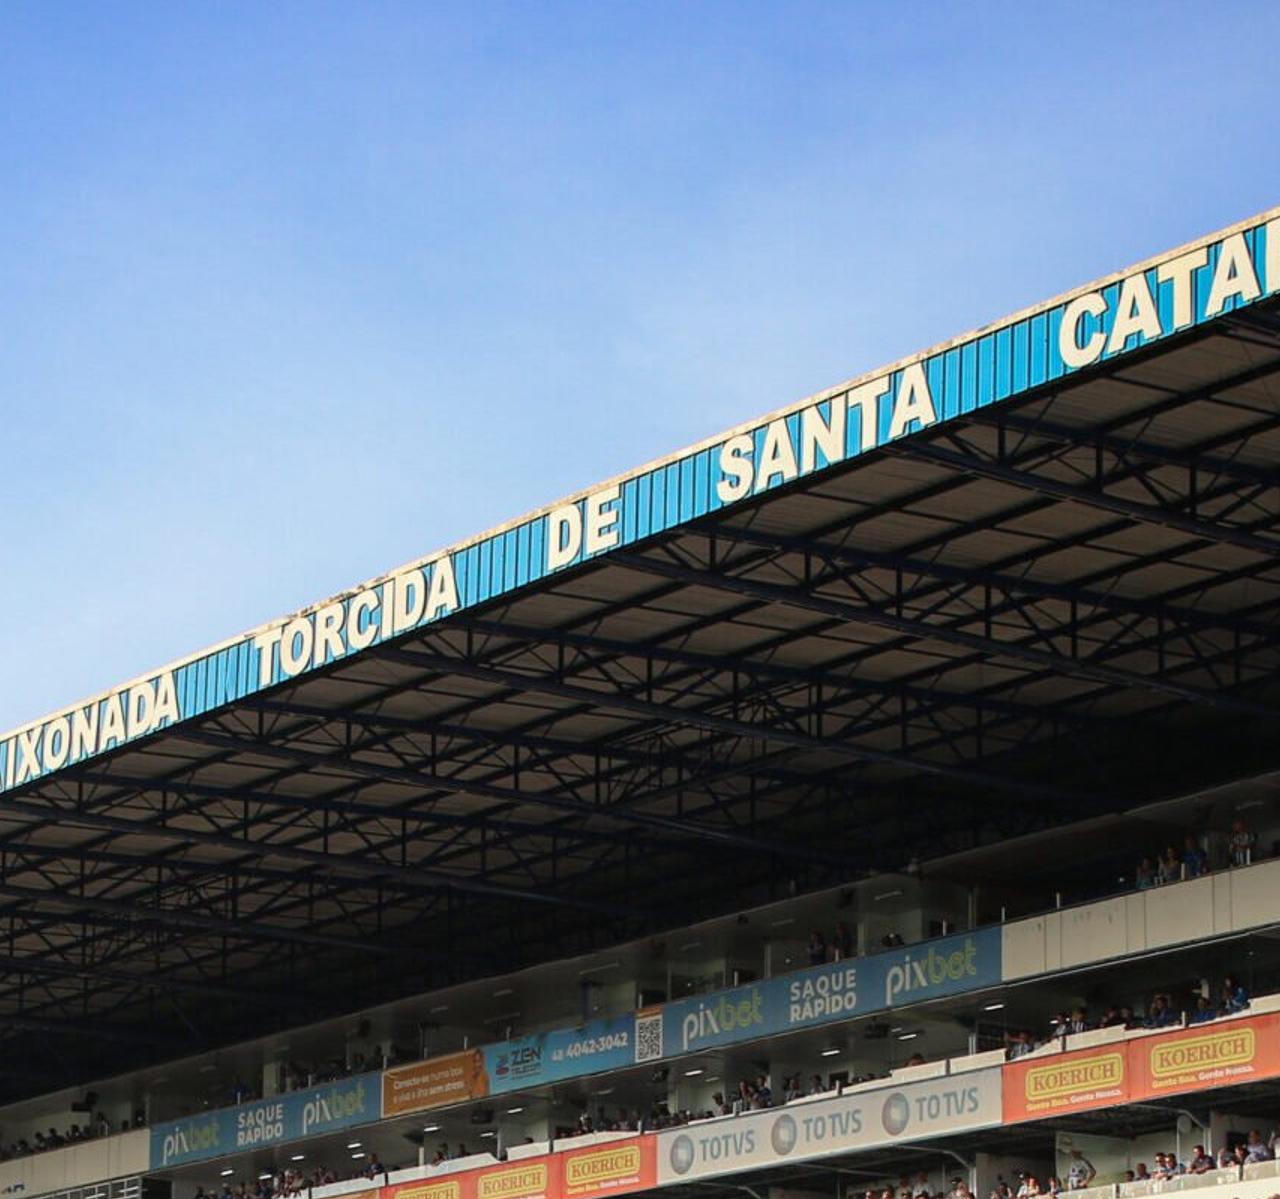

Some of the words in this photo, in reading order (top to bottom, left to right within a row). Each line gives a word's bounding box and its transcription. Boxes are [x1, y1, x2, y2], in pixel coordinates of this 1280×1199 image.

[253, 555, 462, 686] TORCIDA
[546, 484, 620, 572] DE
[716, 360, 937, 503] SANTA
[789, 968, 857, 1002] SAQUE
[885, 940, 977, 1006] pixbet
[682, 989, 763, 1051] pixbet
[1157, 1035, 1246, 1067] KOERICH
[1033, 1060, 1116, 1094] KOERICH
[238, 1103, 283, 1129] SAQUE
[303, 1083, 365, 1134] pixbet
[915, 1086, 979, 1122] TOTVS
[802, 1108, 863, 1142] TOTVS
[699, 1129, 756, 1162] TOTVS
[572, 1153, 635, 1177] KOERICH
[482, 1170, 543, 1195] KOERICH
